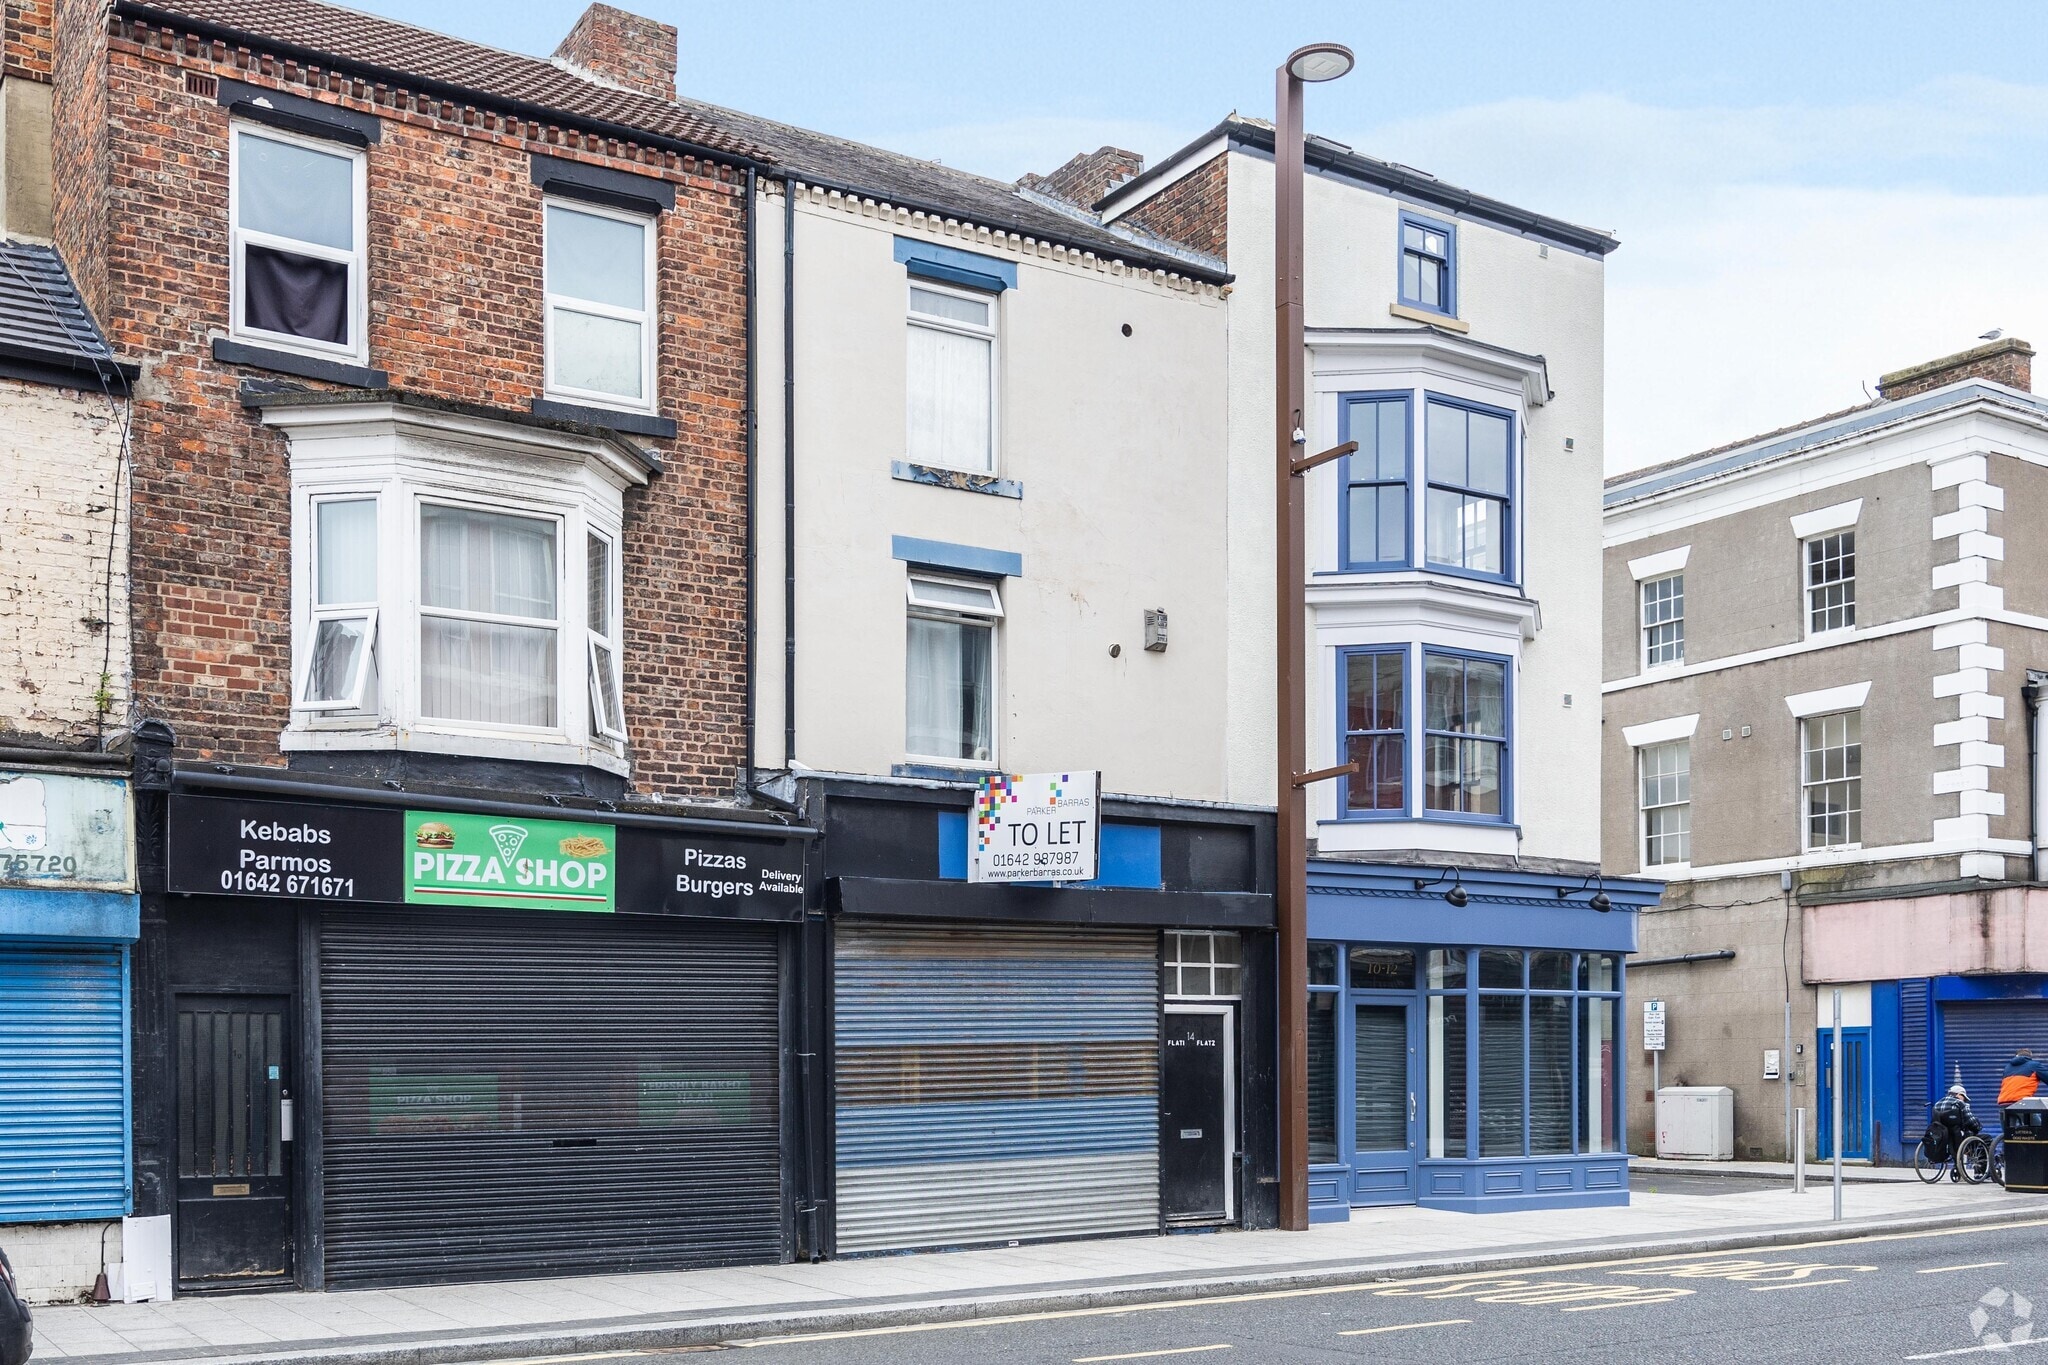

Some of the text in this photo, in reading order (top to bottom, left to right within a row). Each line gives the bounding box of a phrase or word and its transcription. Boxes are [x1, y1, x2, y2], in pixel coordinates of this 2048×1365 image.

[1026, 806, 1057, 816] PARKER
[1057, 798, 1090, 808] BARRAS
[240, 819, 331, 845] Kebabs
[1007, 820, 1086, 847] TO LET
[239, 849, 331, 874] Parmos
[684, 849, 746, 870] Pizzas
[993, 851, 1079, 867] 01642 987987
[414, 852, 607, 889] PIZZA SHOP
[761, 868, 801, 883] Delivery
[987, 867, 1084, 878] www.parkerbarras.co.uk
[220, 870, 354, 898] 01642 671671
[676, 874, 753, 899] Burgers
[759, 881, 803, 895] Available
[1367, 962, 1398, 975] 10-12
[1186, 1031, 1195, 1041] 14
[1608, 1260, 1878, 1281] BUS
[1372, 1280, 1698, 1306] STOP
